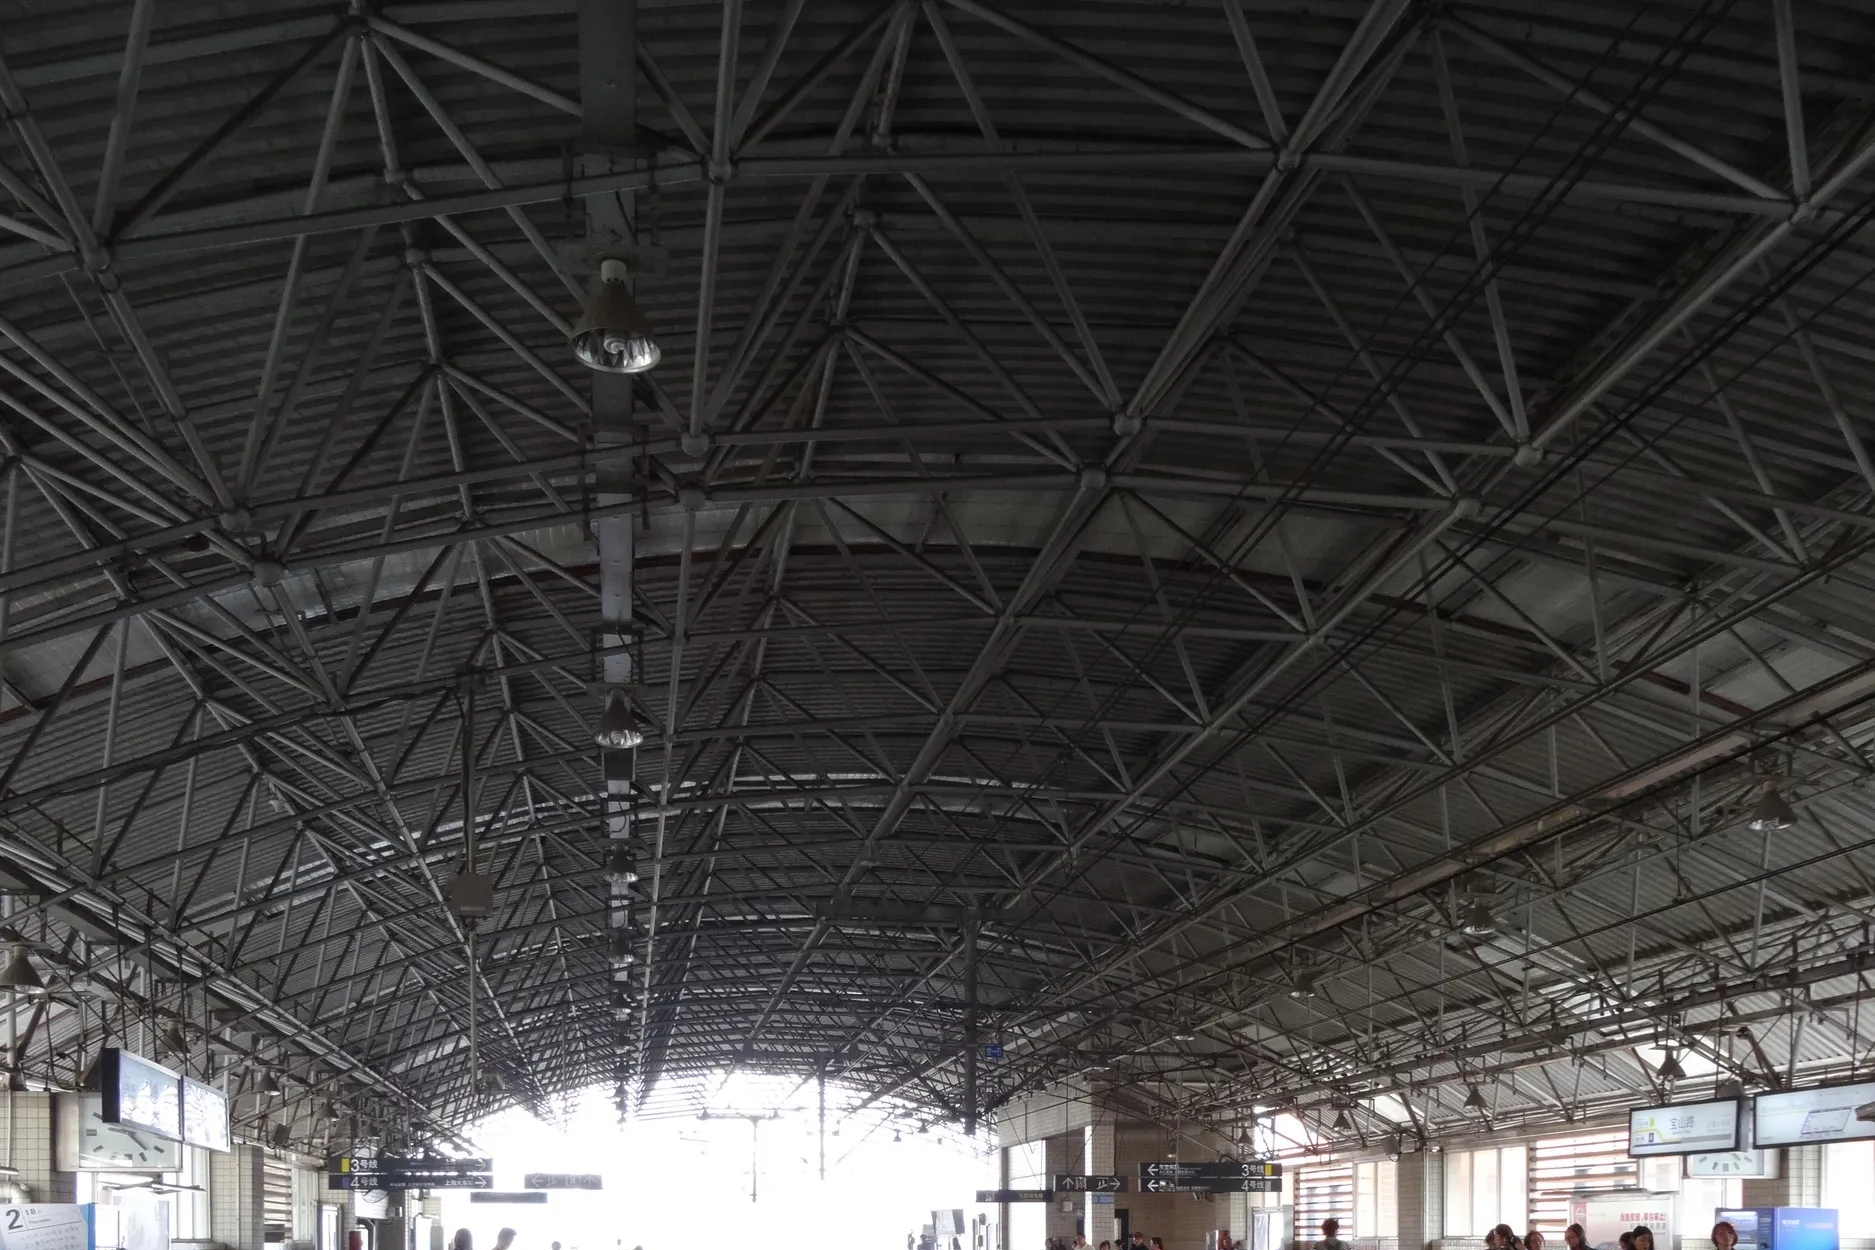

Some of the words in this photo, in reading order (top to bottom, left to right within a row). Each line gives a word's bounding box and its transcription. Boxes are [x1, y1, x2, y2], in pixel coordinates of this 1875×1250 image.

[1669, 1115, 1695, 1130] 宝山路
[350, 1159, 378, 1172] 3号线
[1241, 1164, 1264, 1177] 3号线
[350, 1176, 378, 1188] 4号线
[1241, 1180, 1264, 1191] 4号线
[5, 1208, 23, 1231] 2
